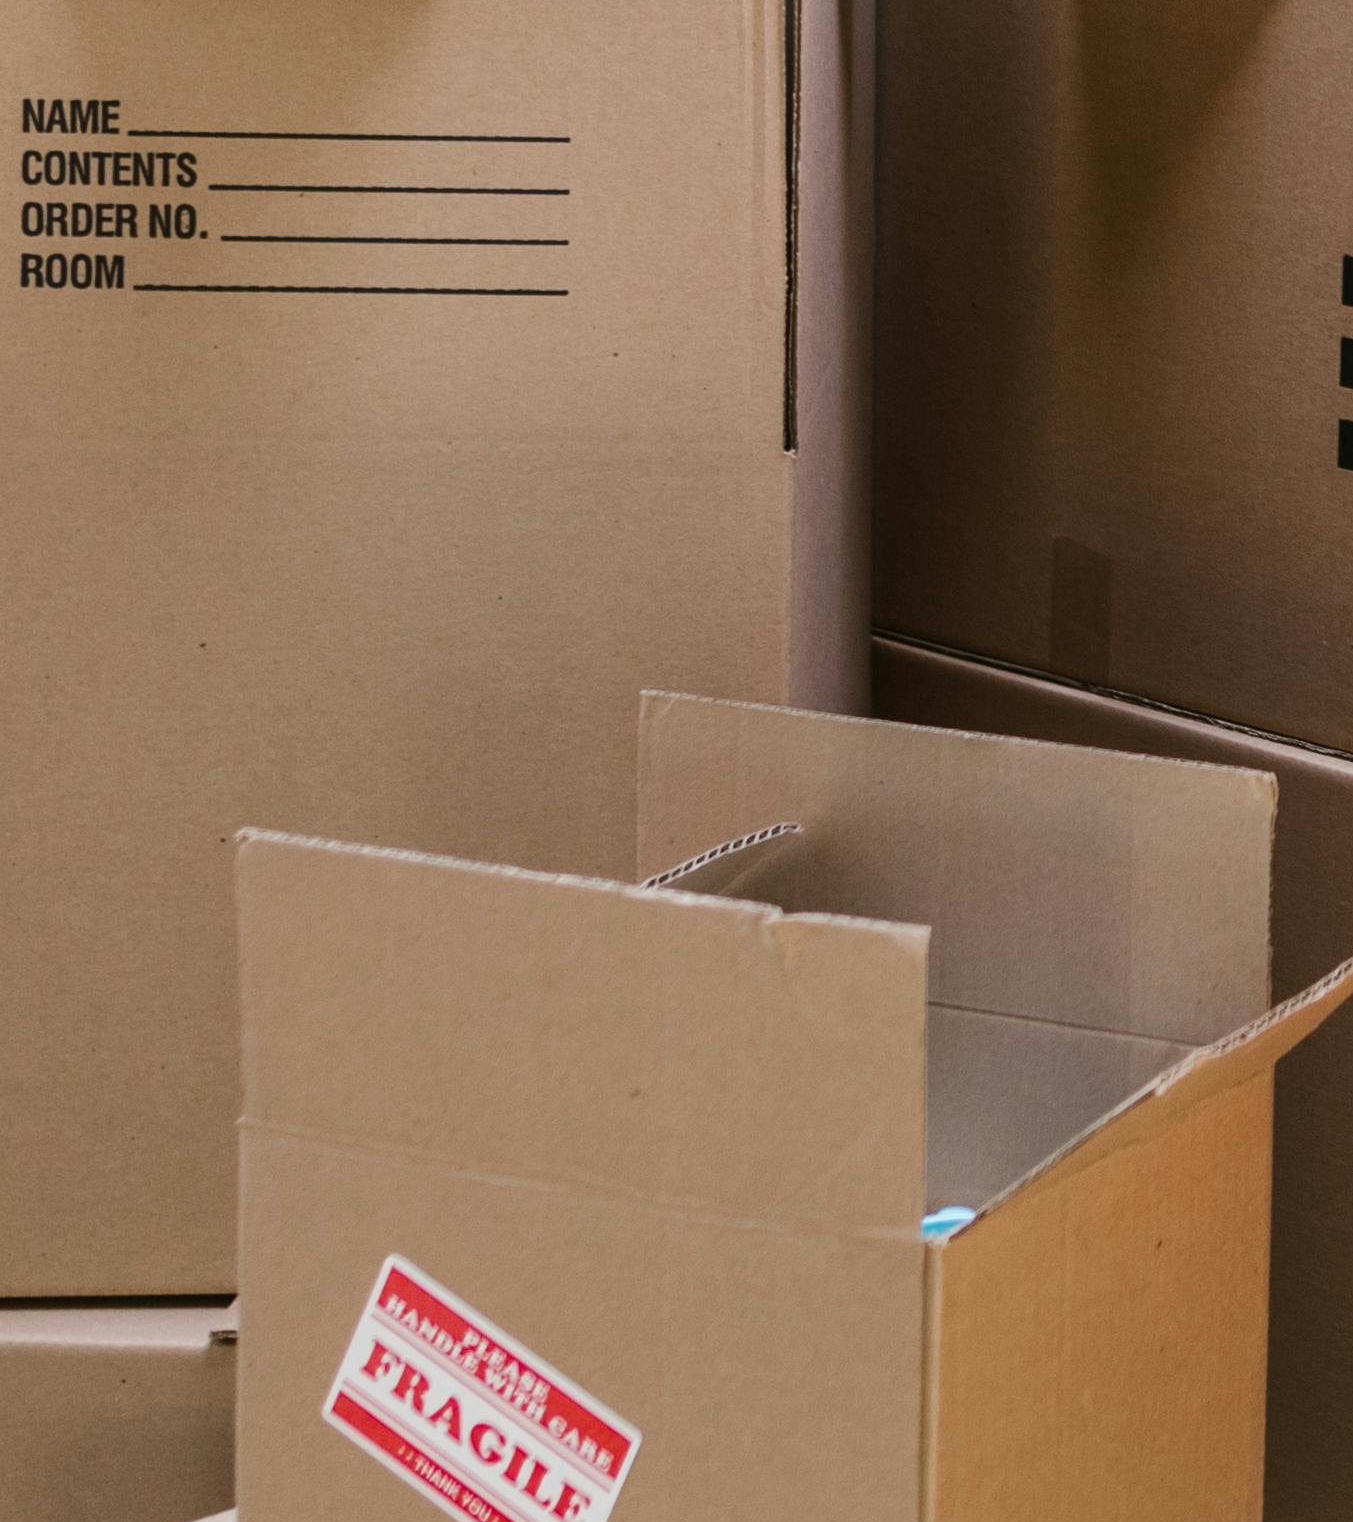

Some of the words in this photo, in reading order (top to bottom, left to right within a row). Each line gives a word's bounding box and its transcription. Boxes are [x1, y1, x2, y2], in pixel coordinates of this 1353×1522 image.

[21, 97, 120, 135] NAME
[21, 150, 197, 188] CONTENTS
[20, 201, 137, 239] ORDER
[149, 203, 208, 240] NO.
[19, 253, 125, 290] ROOM
[386, 1293, 480, 1375] HANDLE
[485, 1366, 547, 1421] WITH
[548, 1415, 615, 1472] CARE
[462, 1329, 550, 1402] PLEASE
[415, 1456, 461, 1501] THANK
[462, 1491, 493, 1522] YOU
